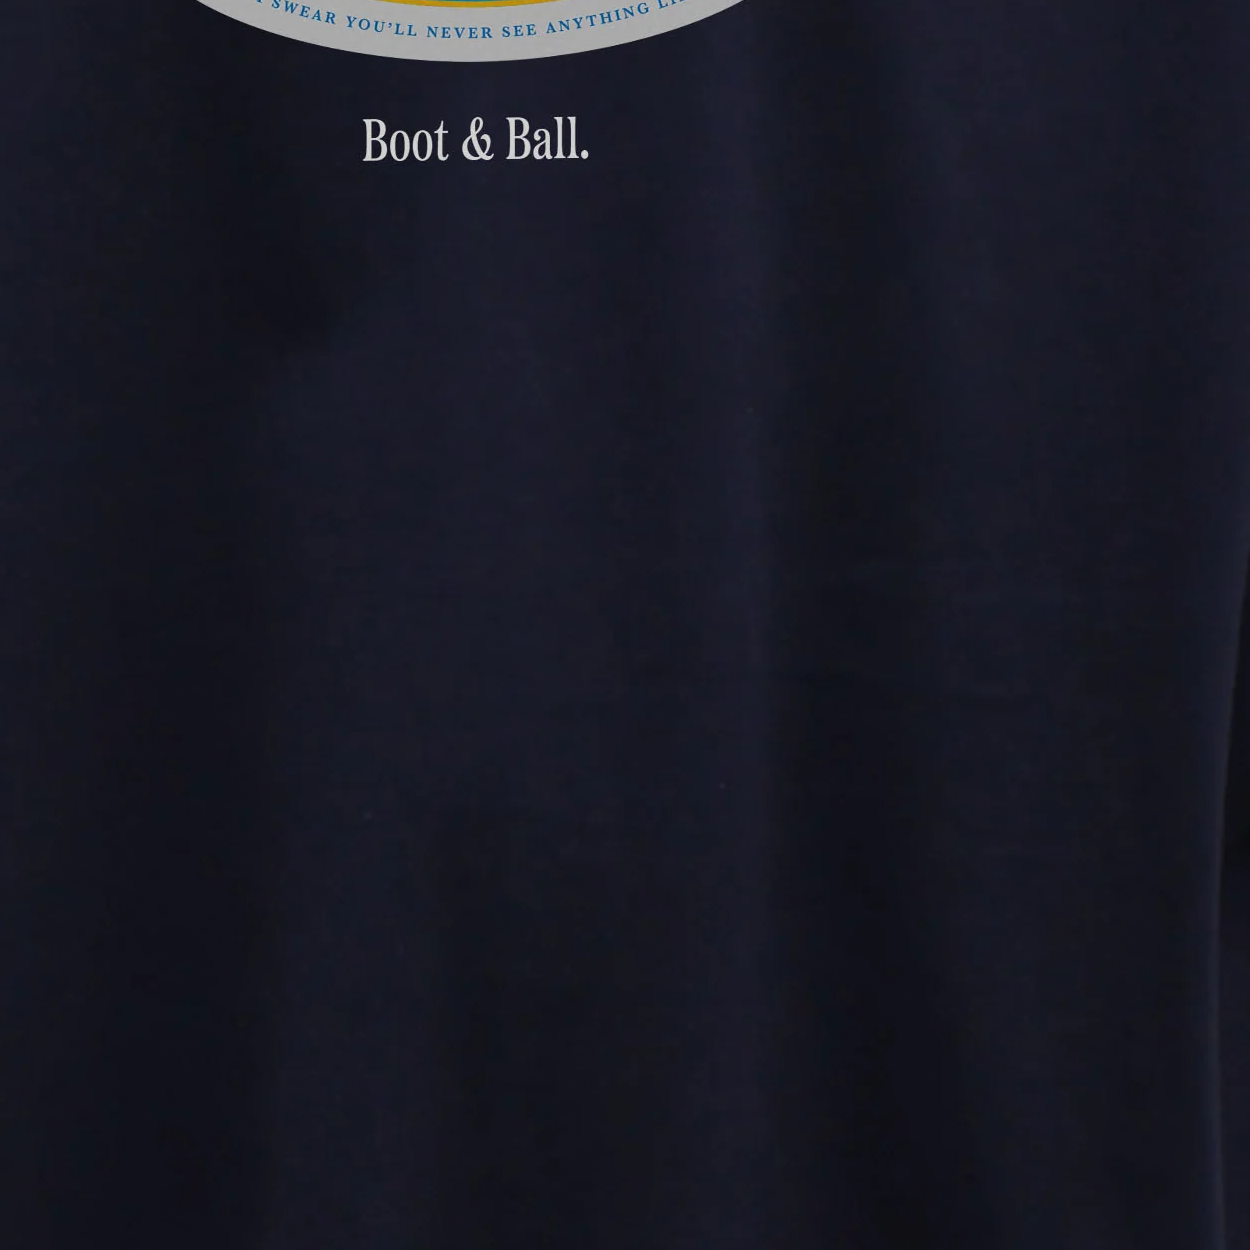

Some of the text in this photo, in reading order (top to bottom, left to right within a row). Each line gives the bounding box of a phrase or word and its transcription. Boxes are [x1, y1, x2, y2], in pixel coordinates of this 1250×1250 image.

[346, 15, 417, 37] YOU’LL
[426, 26, 493, 39] NEVER
[502, 23, 537, 38] SEE
[546, 2, 650, 34] ANYTHING
[362, 116, 589, 162] Boot & Ball.
